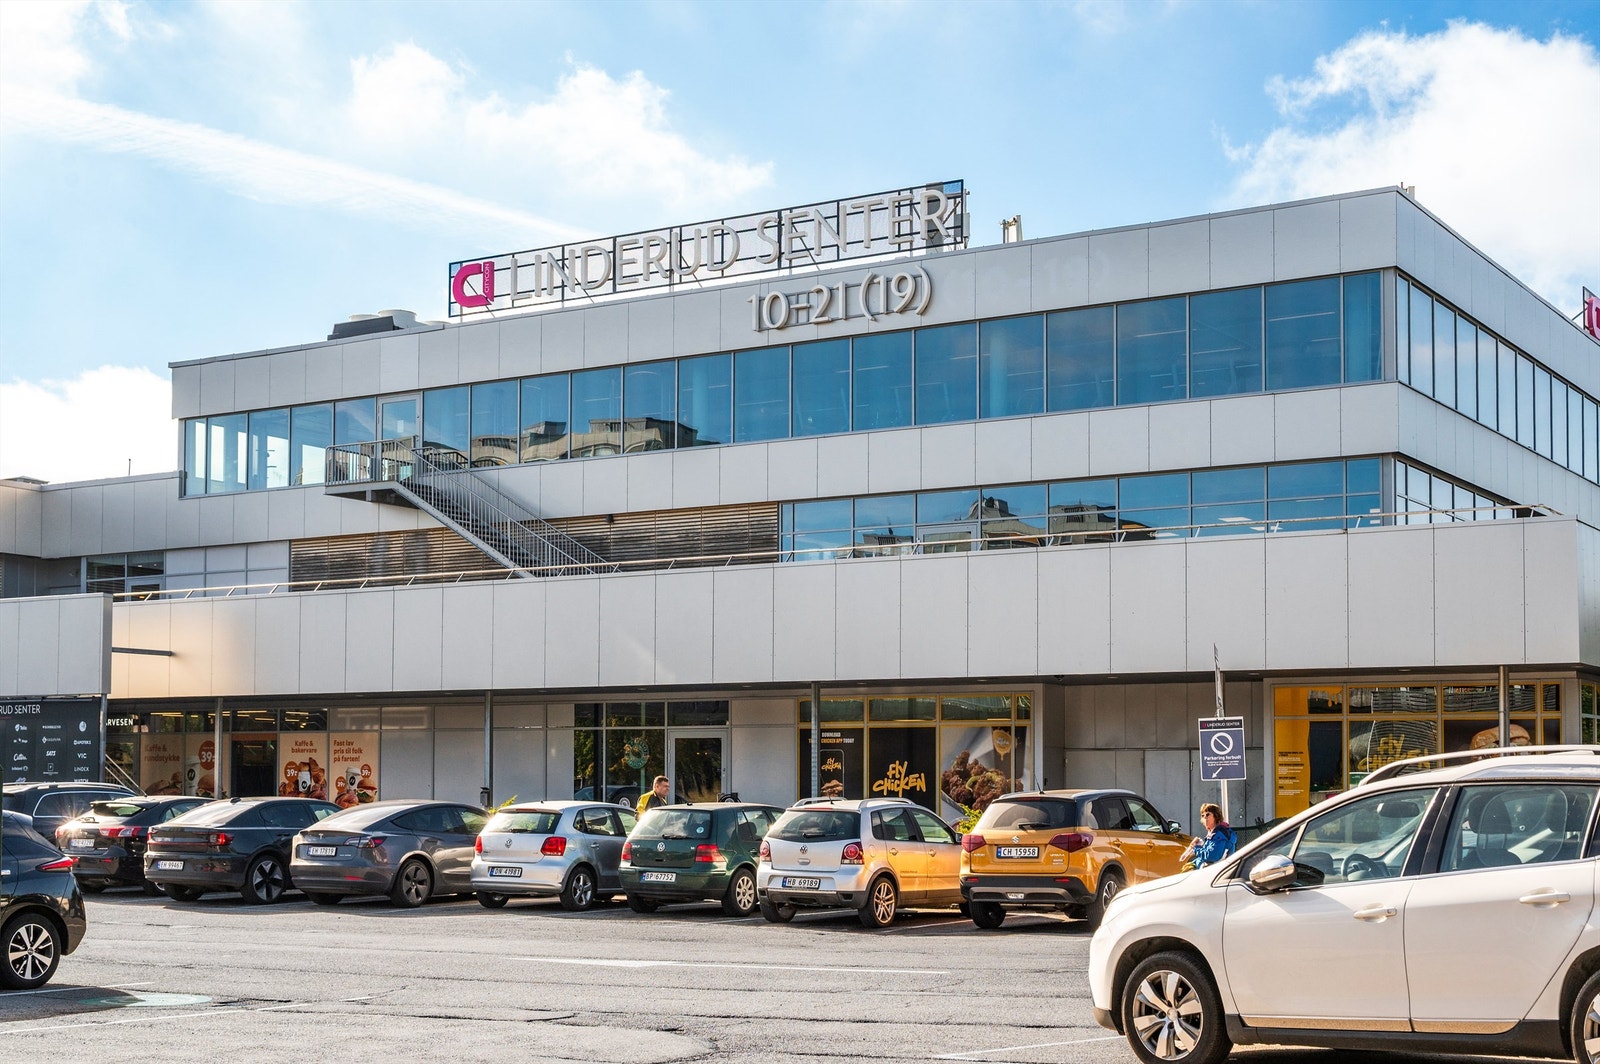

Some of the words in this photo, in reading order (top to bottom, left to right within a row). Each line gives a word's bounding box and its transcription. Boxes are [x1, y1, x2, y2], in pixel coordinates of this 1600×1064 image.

[510, 225, 740, 300] LINDERUD
[756, 189, 950, 264] SENTER
[859, 265, 931, 321] (19)
[14, 705, 41, 714] SENTER
[105, 718, 134, 726] RVESEN
[1002, 848, 1013, 856] CH
[1015, 848, 1036, 856] 15958
[655, 873, 674, 881] 67752
[788, 878, 796, 886] HB
[798, 879, 818, 887] 69189
